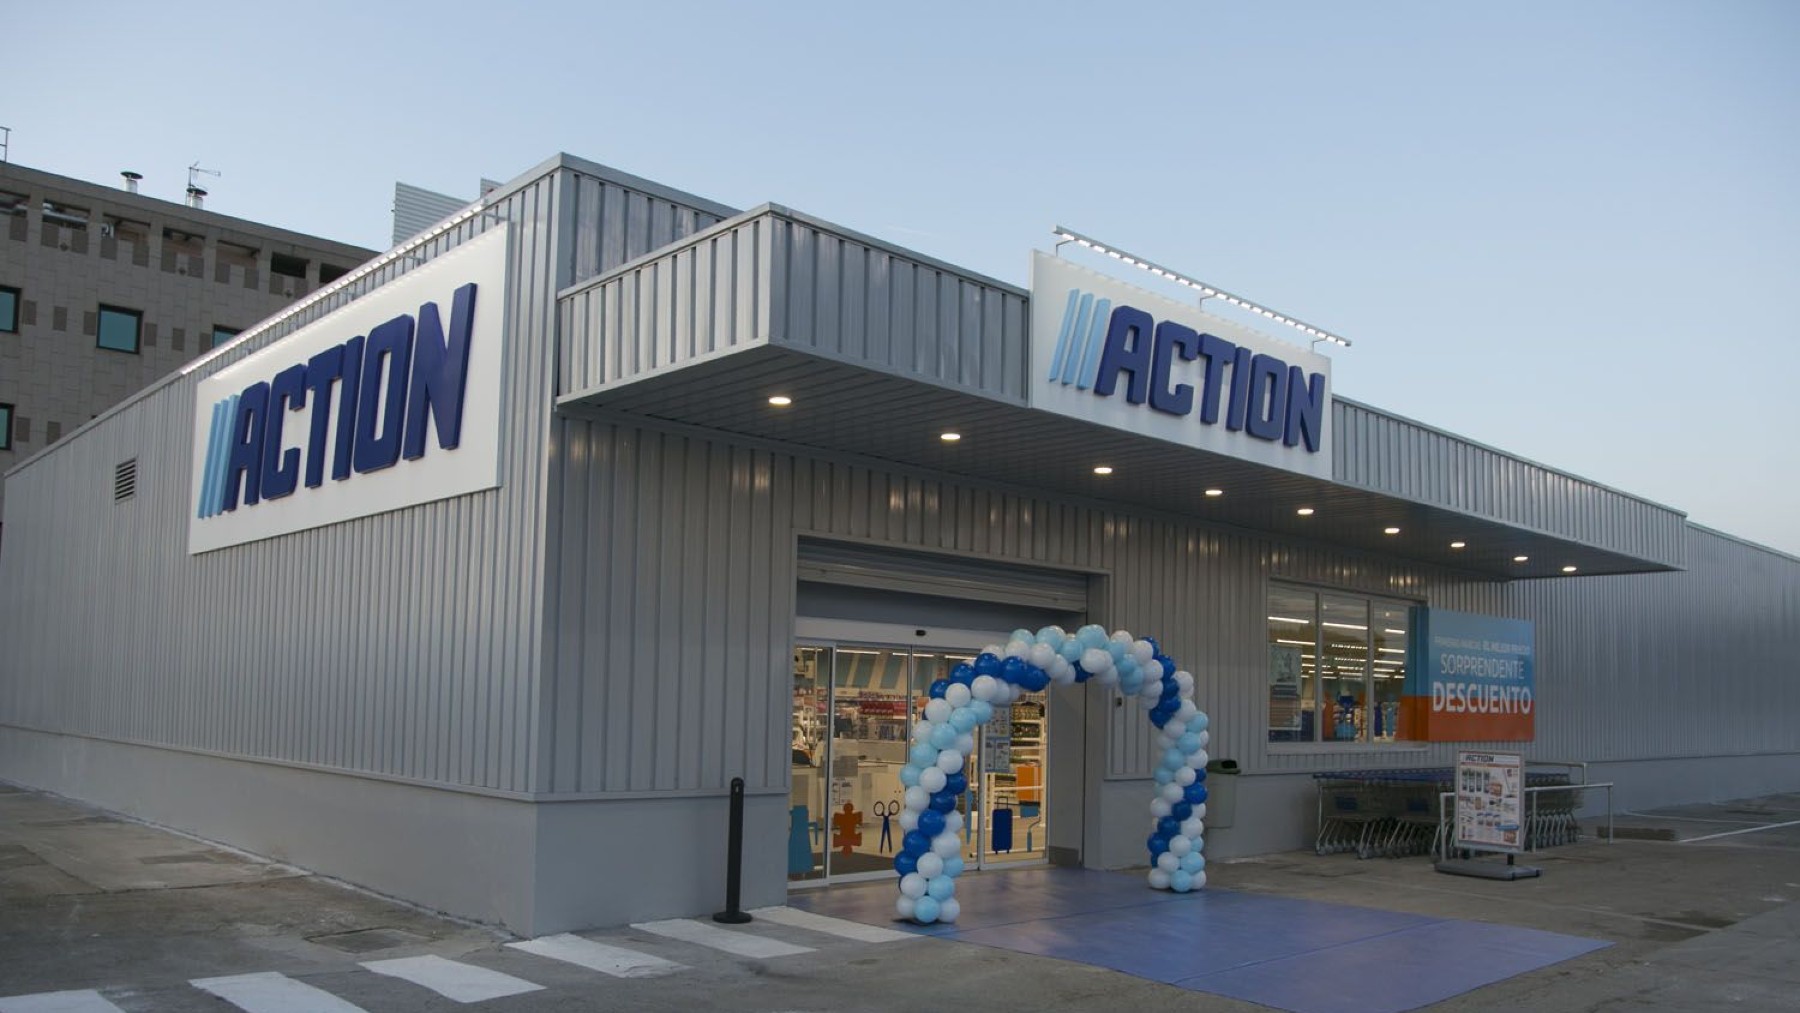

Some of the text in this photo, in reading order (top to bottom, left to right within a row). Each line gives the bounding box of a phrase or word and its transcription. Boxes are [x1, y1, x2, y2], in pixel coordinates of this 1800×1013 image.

[223, 282, 477, 512] ACTION
[1094, 305, 1325, 453] ACTION
[1433, 681, 1531, 714] DESCUENTO
[1440, 653, 1525, 679] SORPRENDENTE
